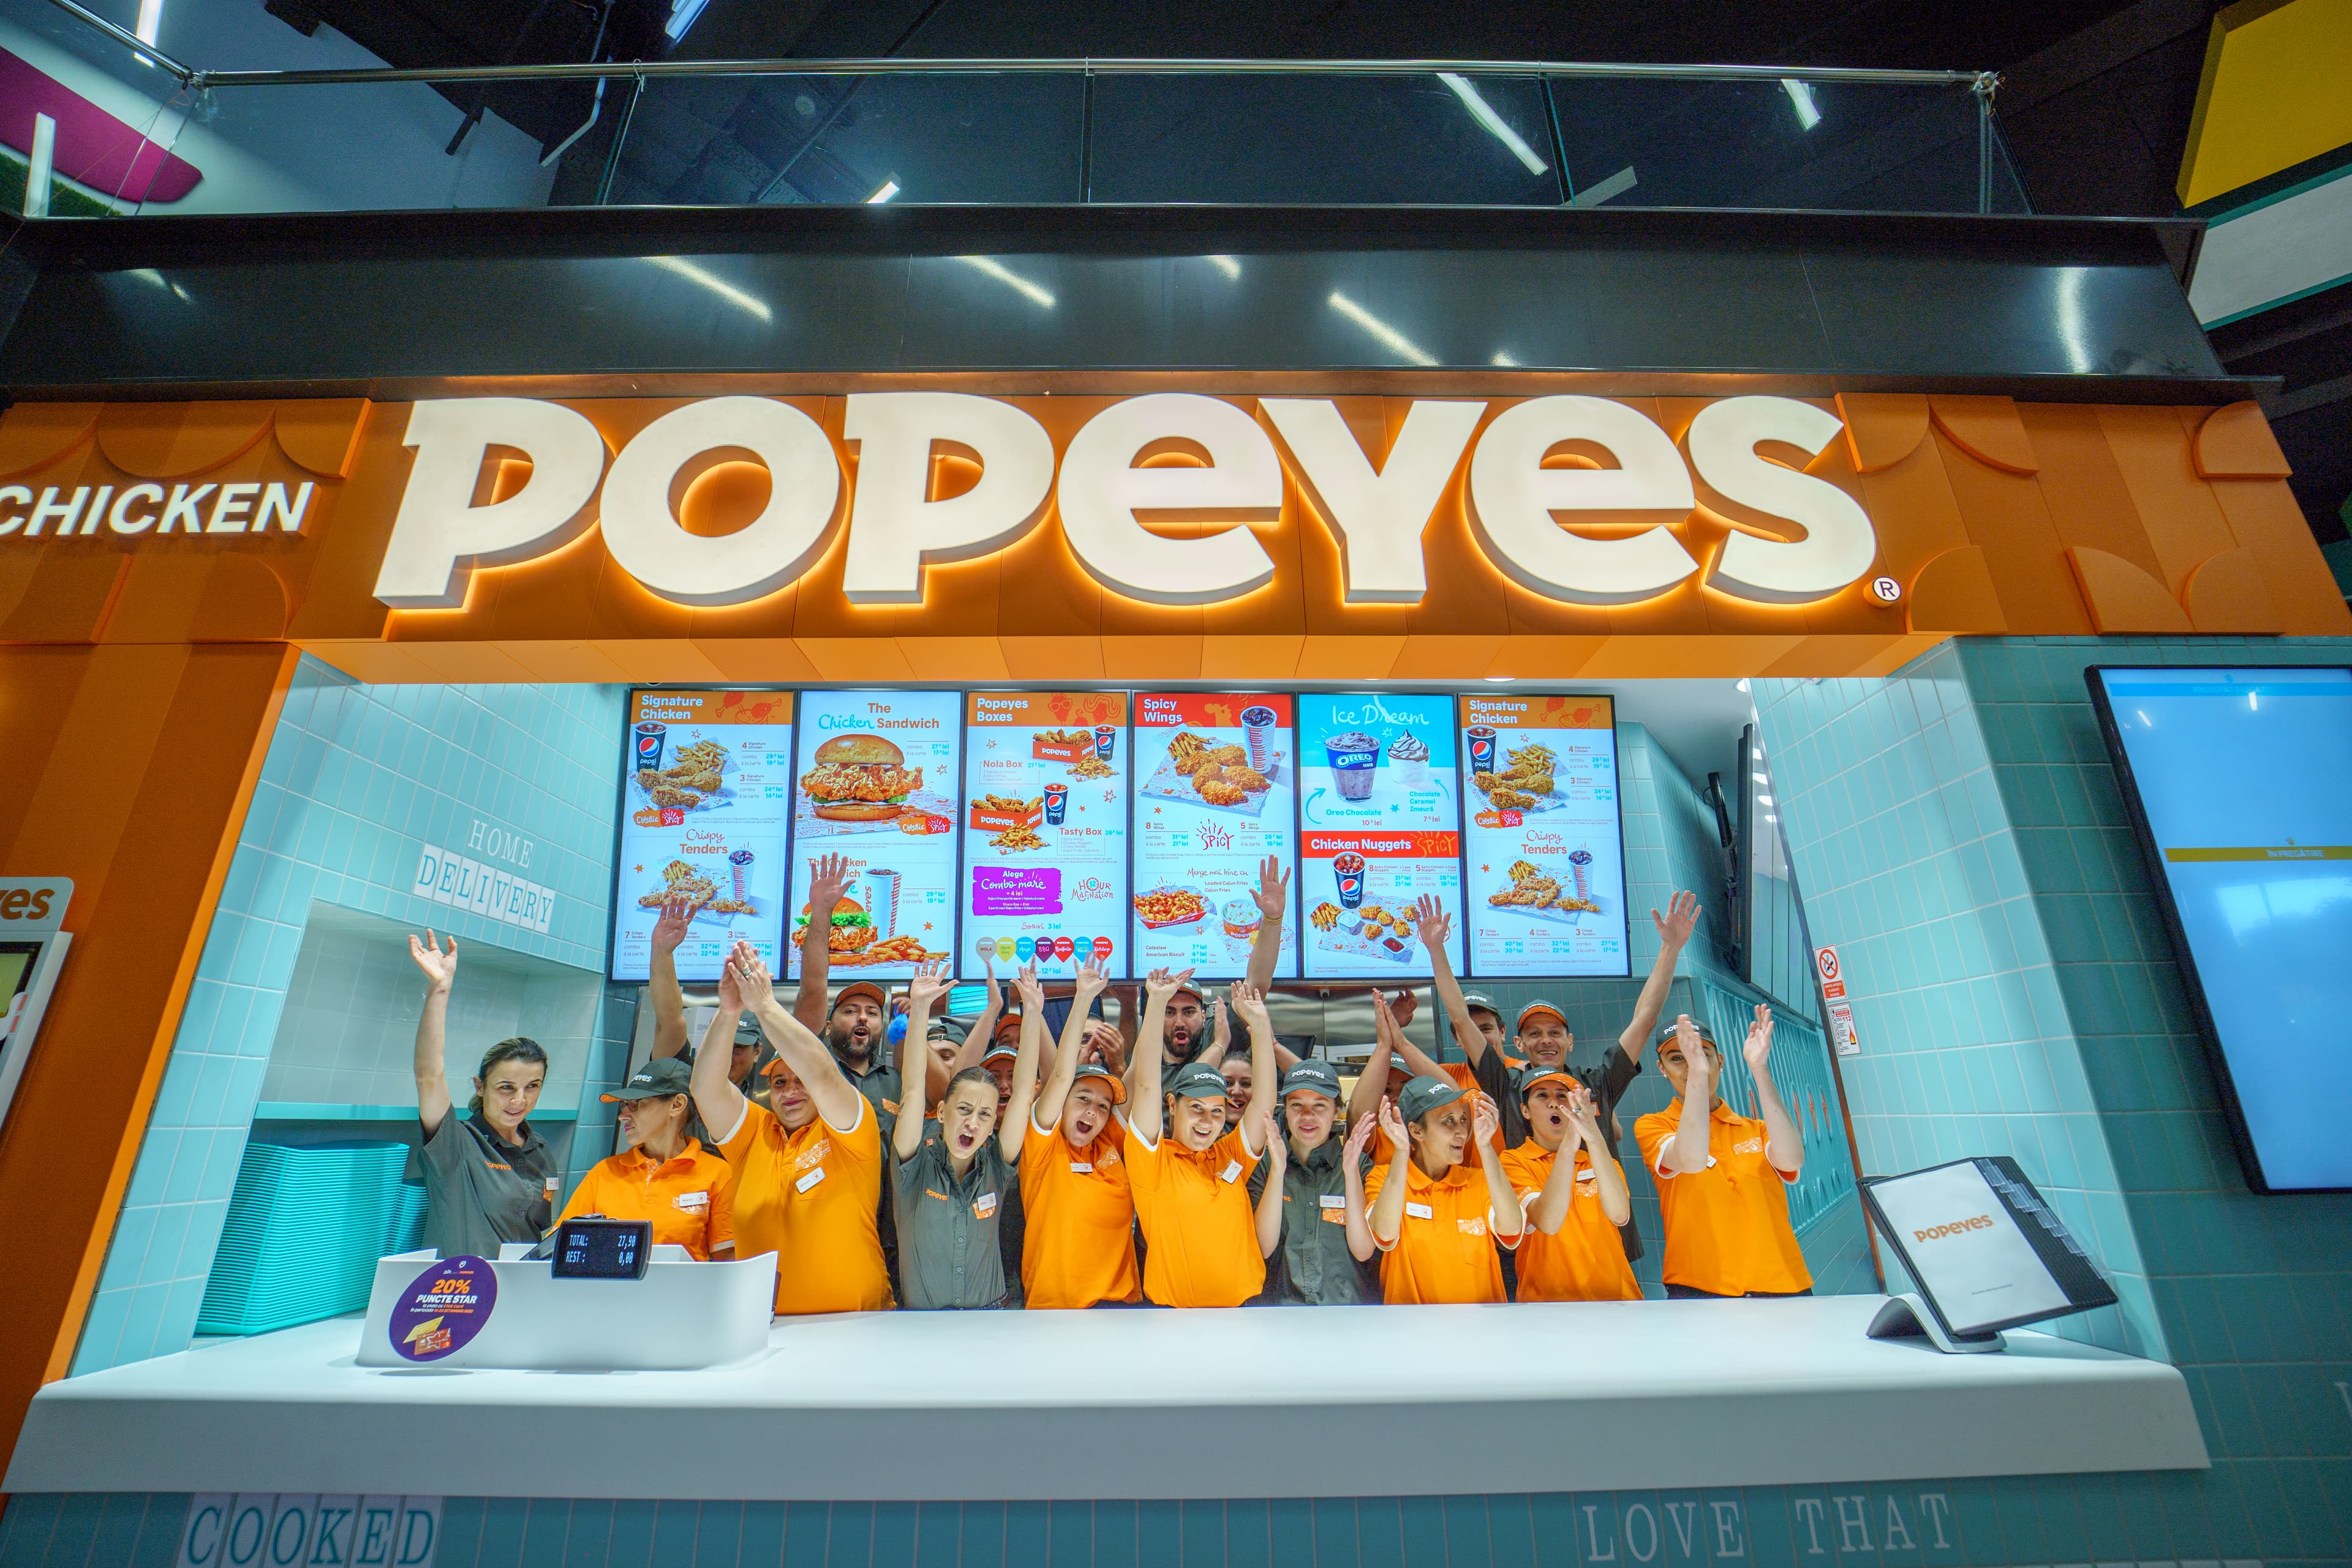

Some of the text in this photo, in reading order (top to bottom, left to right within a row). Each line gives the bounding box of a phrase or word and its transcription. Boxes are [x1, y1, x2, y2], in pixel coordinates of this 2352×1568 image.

[0, 482, 314, 535] CHICKEN
[642, 695, 703, 707] Signature
[977, 698, 1028, 710] Popeyes
[1144, 699, 1177, 710] Spicy
[1469, 700, 1527, 712] Signature
[868, 703, 891, 712] The
[641, 709, 691, 719] Chicken
[977, 711, 1012, 722] Boxes
[1144, 712, 1182, 723] Wings
[1333, 703, 1429, 725] Ice Dream
[1470, 714, 1518, 724] Chicken
[818, 714, 940, 729] Chicken Sandwich
[1337, 753, 1372, 766] OREO
[686, 829, 725, 843] Crispy
[1526, 830, 1563, 843] Crispy
[468, 819, 533, 868] HOME
[680, 843, 728, 853] Tenders
[1311, 839, 1411, 851] Chicken Nuggets
[1521, 845, 1567, 854] Tenders
[1187, 869, 1208, 877] Merge
[418, 855, 552, 923] DELIVERY
[981, 879, 1046, 890] Combo mare
[570, 1235, 636, 1250] TOTAL: 27,90
[566, 1251, 581, 1262] REST
[619, 1252, 633, 1266] 0,00
[431, 1279, 472, 1294] 20%
[1583, 1494, 1950, 1561] LOVE THAT
[188, 1506, 434, 1566] COOKED
